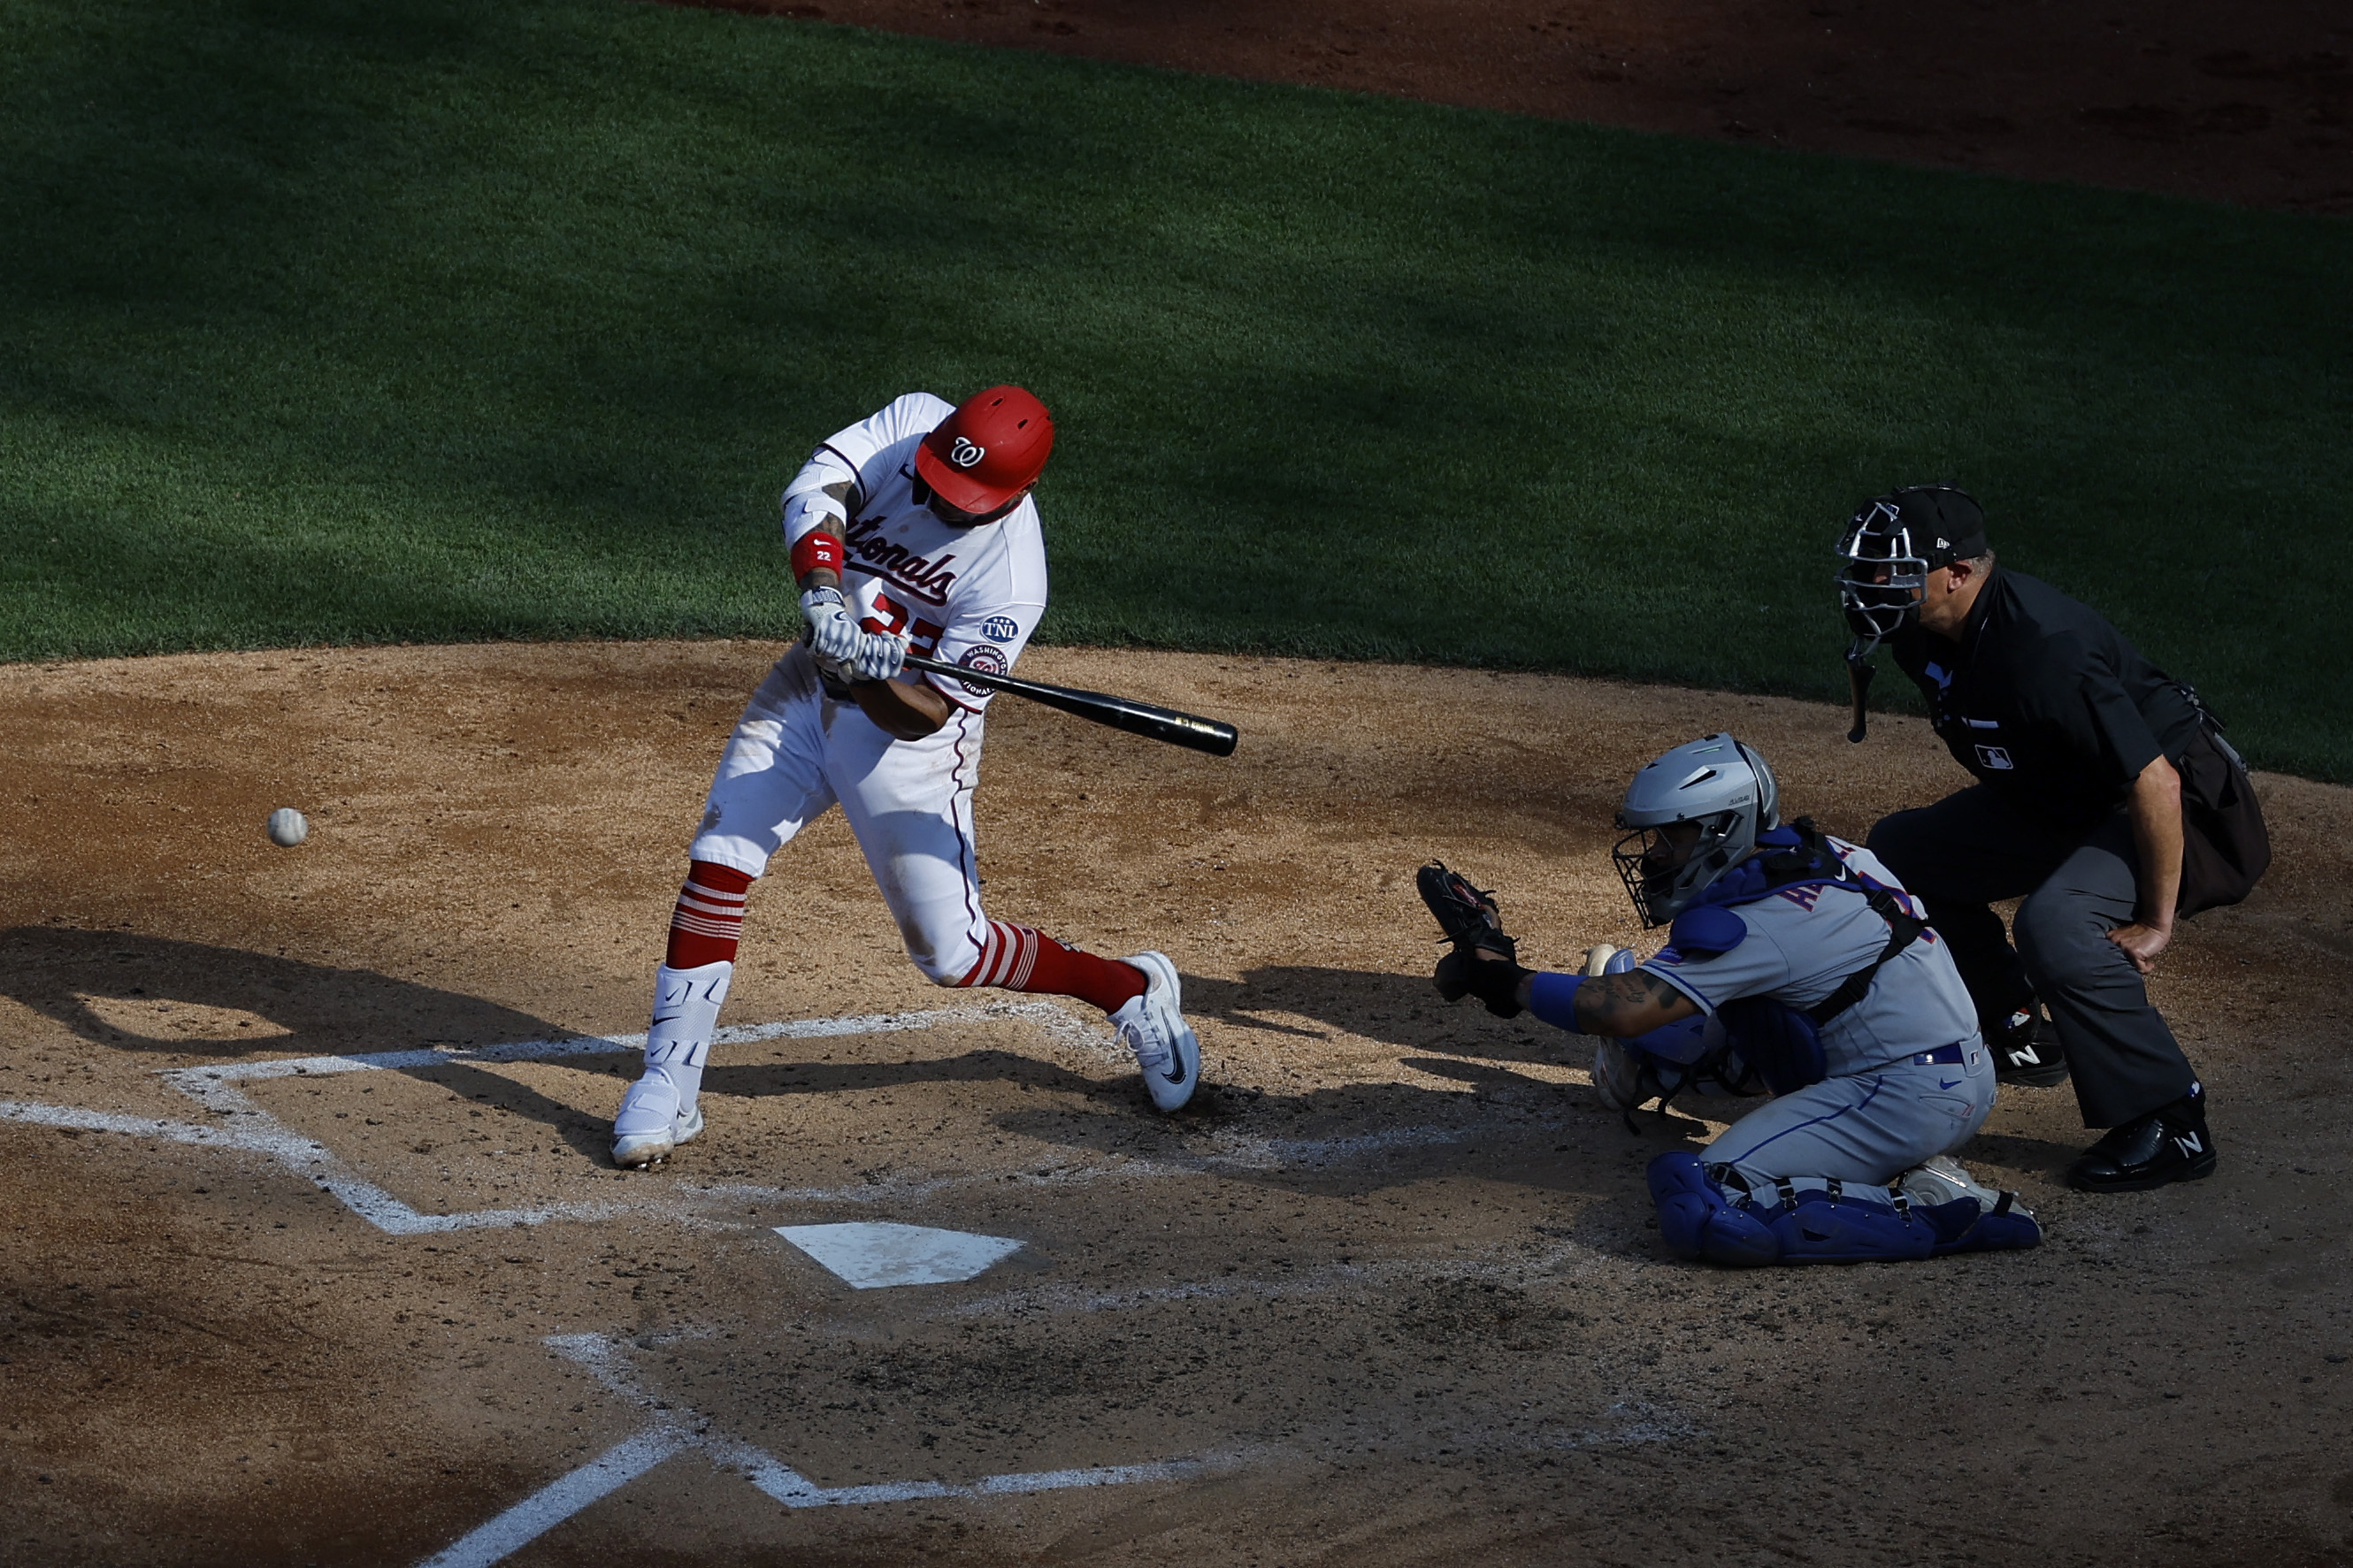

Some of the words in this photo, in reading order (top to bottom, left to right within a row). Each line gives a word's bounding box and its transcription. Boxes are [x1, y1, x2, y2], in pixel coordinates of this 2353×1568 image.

[817, 550, 832, 562] 22
[984, 622, 1017, 639] TNL
[962, 680, 995, 695] TIONAL
[2004, 1044, 2041, 1067] N
[2173, 1130, 2204, 1159] N
